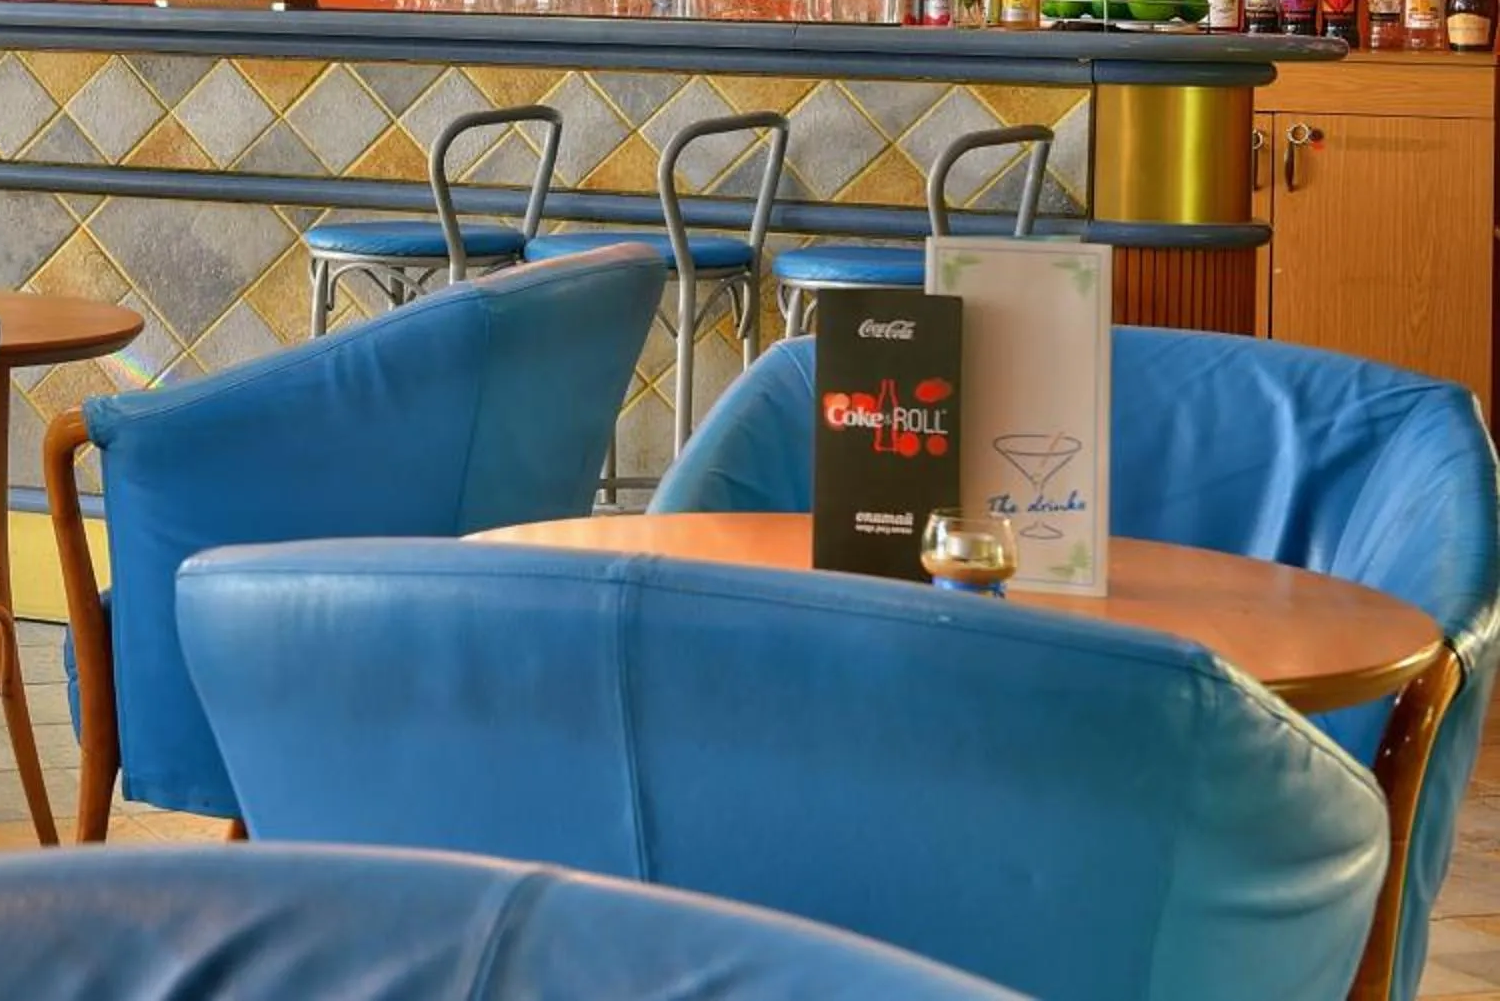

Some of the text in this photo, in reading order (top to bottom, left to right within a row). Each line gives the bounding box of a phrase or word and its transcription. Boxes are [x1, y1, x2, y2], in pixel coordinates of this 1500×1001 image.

[858, 319, 916, 340] Coca-Cola
[828, 406, 884, 428] Coke
[893, 407, 949, 435] ROLL
[987, 490, 1087, 515] The drinks
